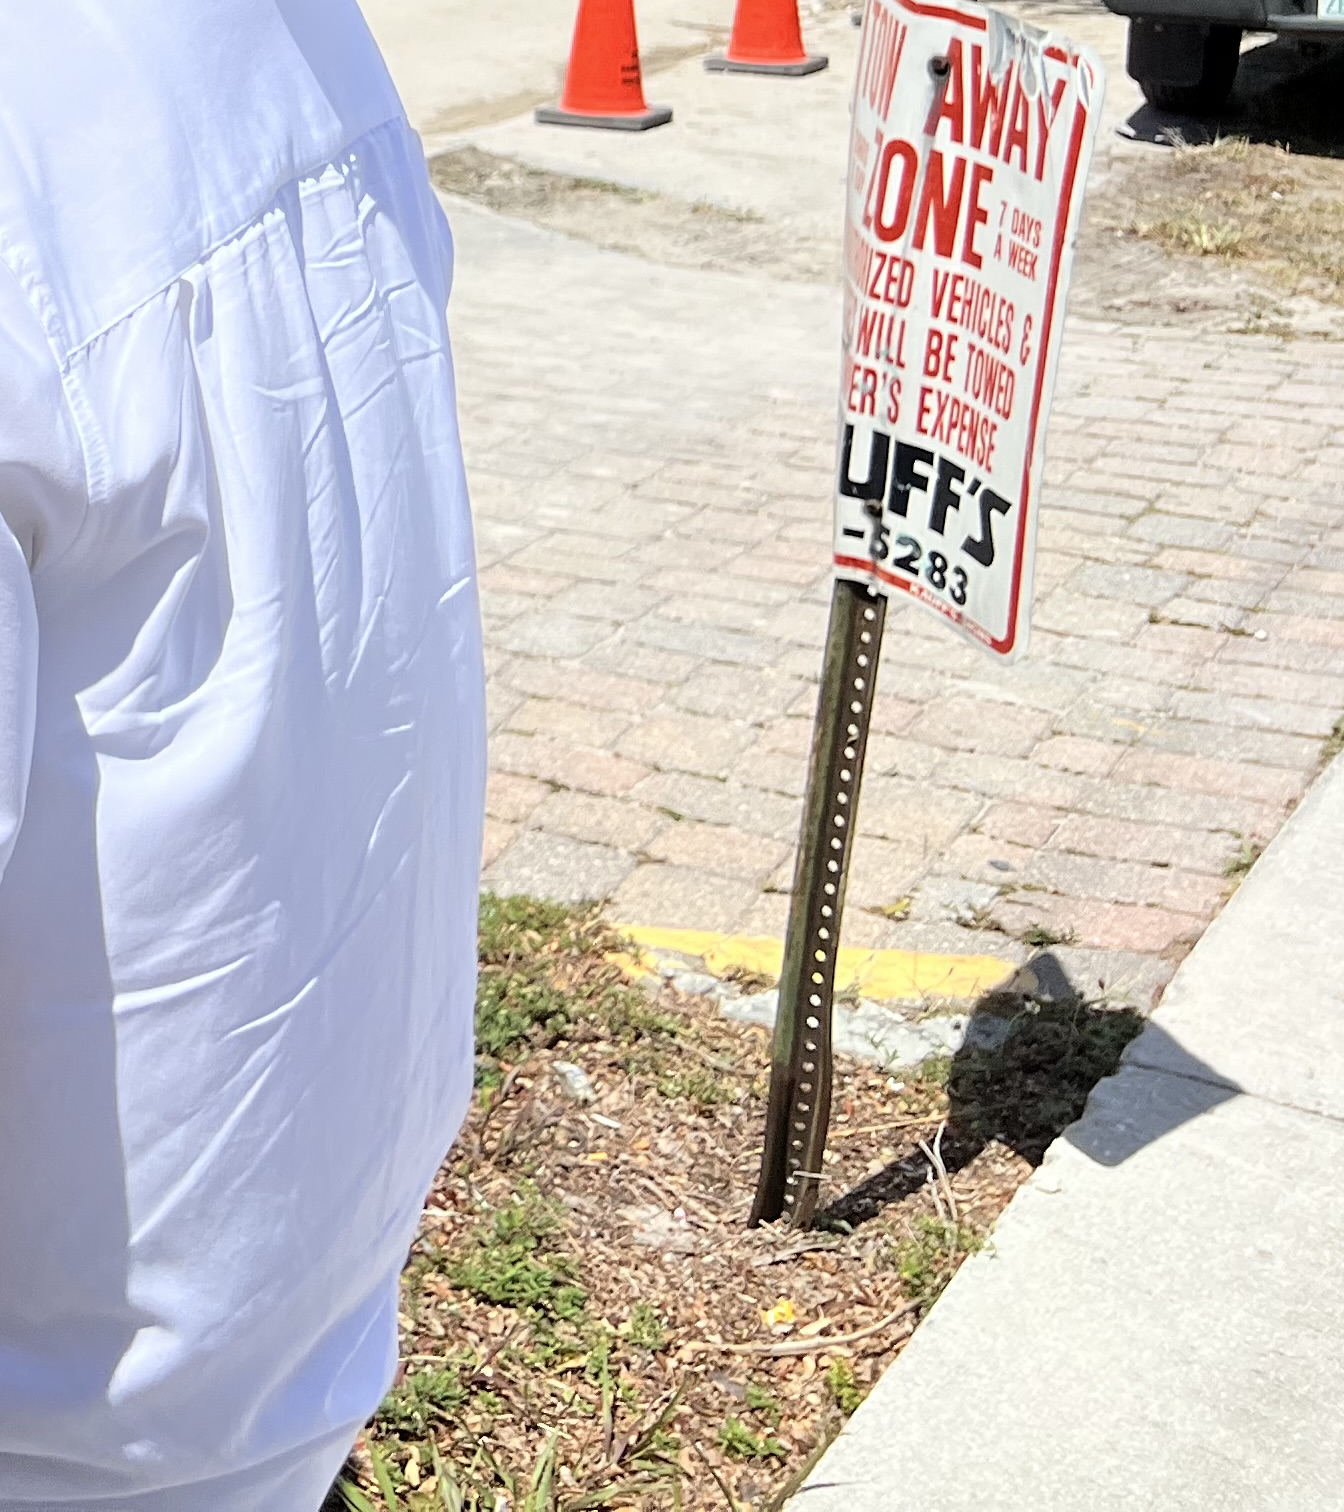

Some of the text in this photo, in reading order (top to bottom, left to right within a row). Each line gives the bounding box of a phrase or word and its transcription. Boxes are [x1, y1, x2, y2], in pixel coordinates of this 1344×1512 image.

[923, 37, 1068, 182] AWAY
[862, 128, 995, 271] ZONE
[999, 200, 1042, 248] 7 DAYS
[993, 234, 1039, 281] A WEEK
[856, 305, 906, 369] WILL
[923, 328, 958, 383] BE
[964, 343, 1016, 421] TOWED
[930, 268, 1015, 355] VEHICLES
[1020, 314, 1033, 366] &
[847, 362, 998, 474] ER'S EXPENSE
